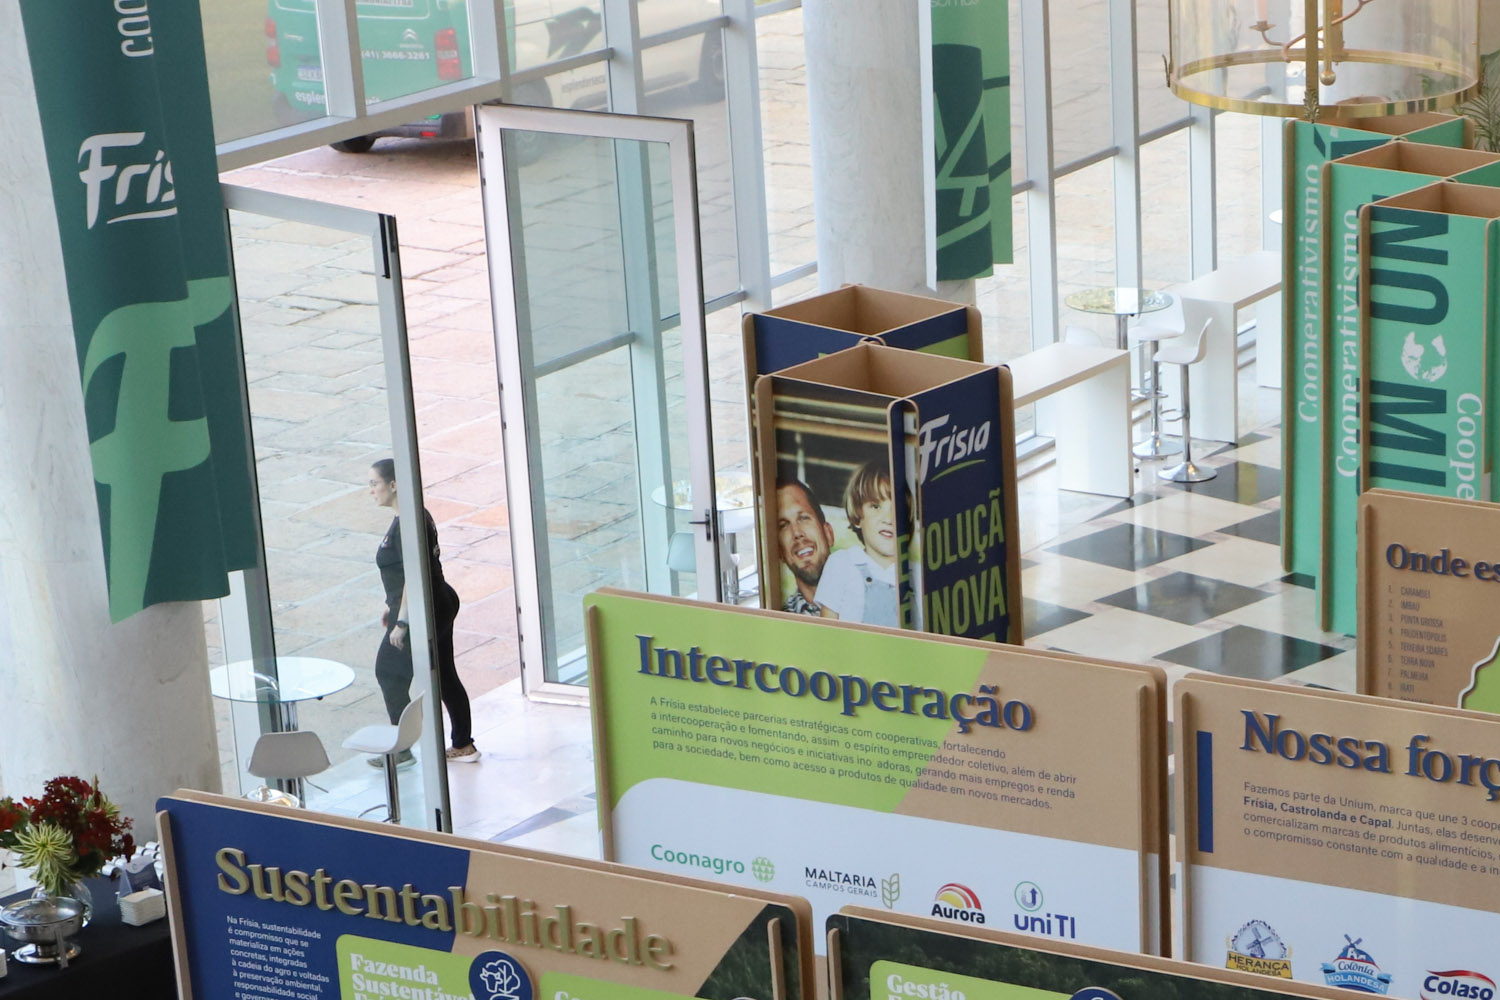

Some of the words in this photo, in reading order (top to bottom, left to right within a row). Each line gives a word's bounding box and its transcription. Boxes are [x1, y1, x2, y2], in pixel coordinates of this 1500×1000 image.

[1385, 542, 1469, 579] Onde
[634, 633, 1037, 734] Intercooperação
[650, 697, 658, 707] A
[660, 697, 686, 710] Frísia
[688, 703, 741, 719] estabelece
[743, 712, 788, 726] parcerias
[790, 718, 849, 736] estratégicas
[851, 727, 873, 739] com
[875, 731, 941, 750] cooperativas,
[943, 740, 1007, 759] fortalecendo
[1239, 708, 1394, 775] Nossa
[1243, 796, 1278, 813] Frísia,
[1280, 802, 1348, 823] Castrolanda
[1350, 813, 1357, 824] e
[1359, 815, 1394, 830] Capal.
[650, 844, 746, 879] Coonagro
[804, 866, 878, 889] MALTARIA
[805, 879, 846, 894] CAMPOS
[847, 884, 879, 898] GERAIS
[214, 846, 677, 973] Sustentabilidade
[931, 903, 987, 925] Aurora
[226, 915, 238, 925] Na
[239, 917, 260, 929] Frísia,
[262, 922, 322, 940] sustentabilidade
[350, 952, 439, 986] Fazenda
[1227, 952, 1290, 972] HERANÇA
[1337, 960, 1375, 977] Colônia
[1327, 973, 1387, 993] HOLANDESA
